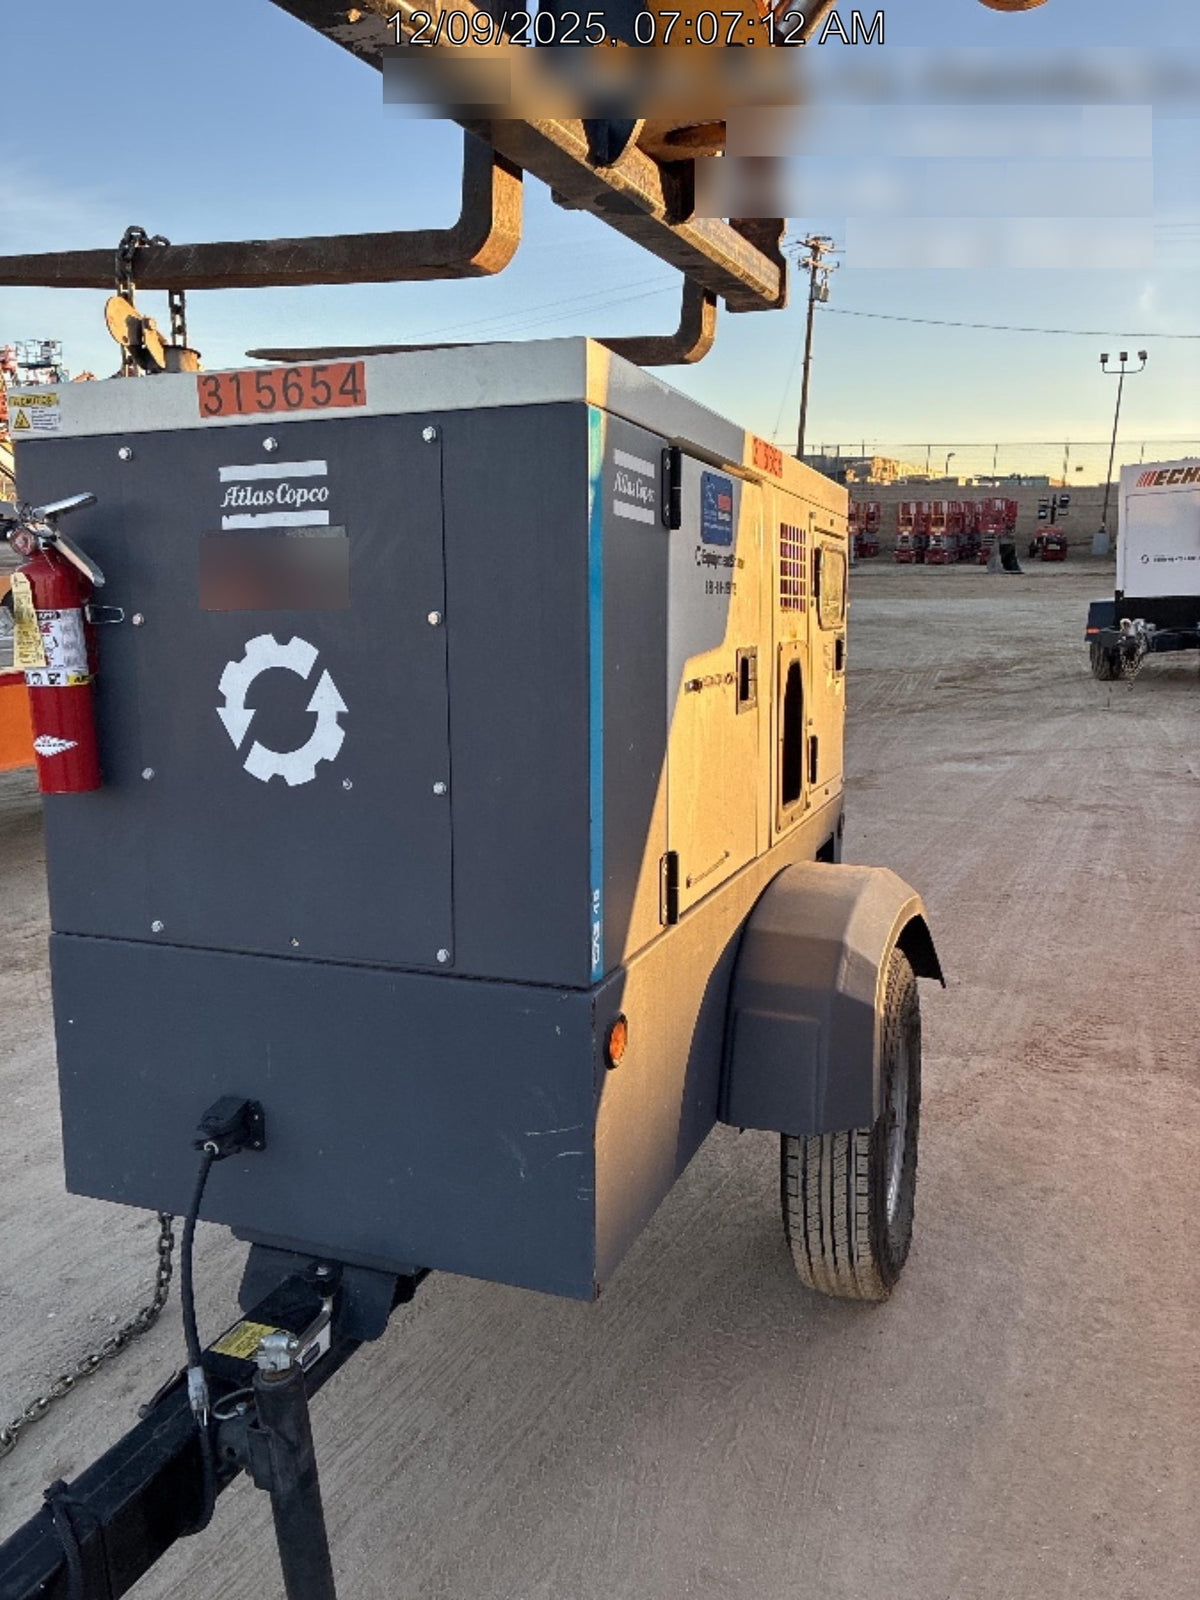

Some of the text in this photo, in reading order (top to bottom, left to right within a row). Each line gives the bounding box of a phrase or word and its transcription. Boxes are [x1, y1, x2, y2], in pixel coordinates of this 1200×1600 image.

[202, 364, 361, 414] 315654
[220, 483, 330, 508] Atlas Copco
